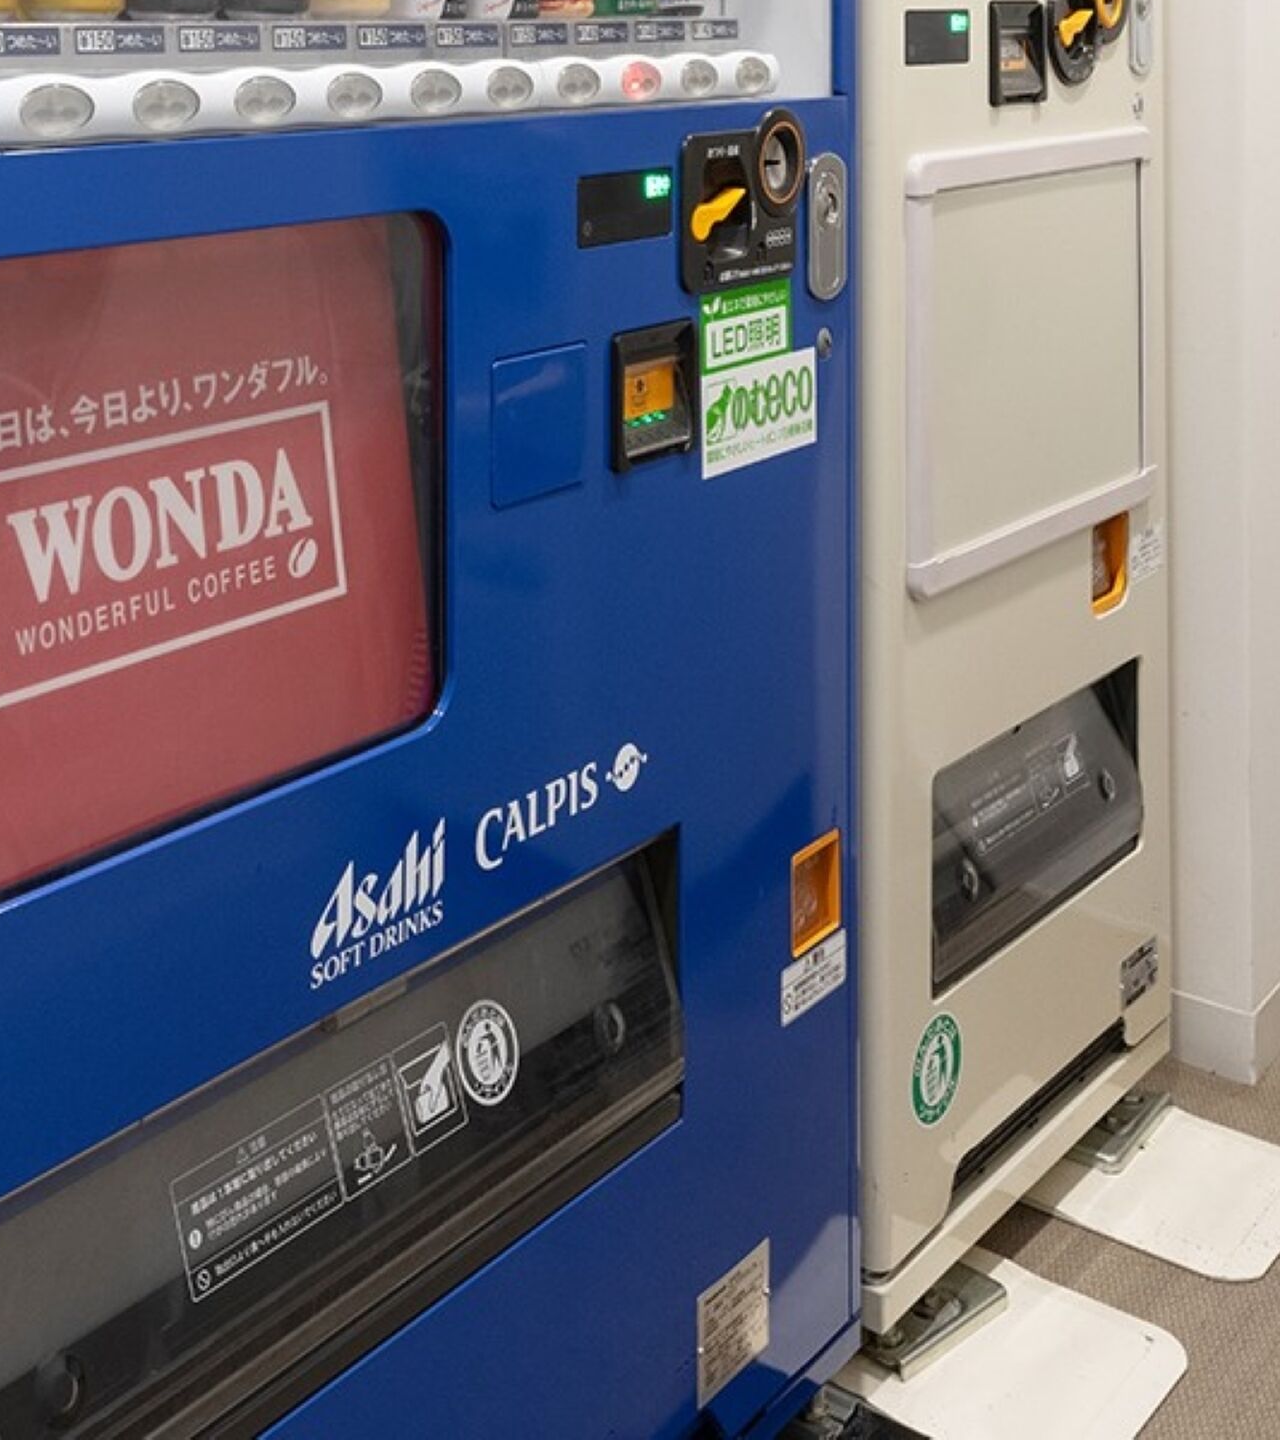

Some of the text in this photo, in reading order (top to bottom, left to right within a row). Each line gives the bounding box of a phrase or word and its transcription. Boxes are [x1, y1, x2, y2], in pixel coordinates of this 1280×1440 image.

[6, 447, 313, 604] WONDA
[15, 556, 277, 656] WONDERFUL COFFEE
[475, 762, 598, 871] CALPIS
[310, 816, 447, 959] Asahi
[310, 899, 444, 991] SOFT DRINKS
